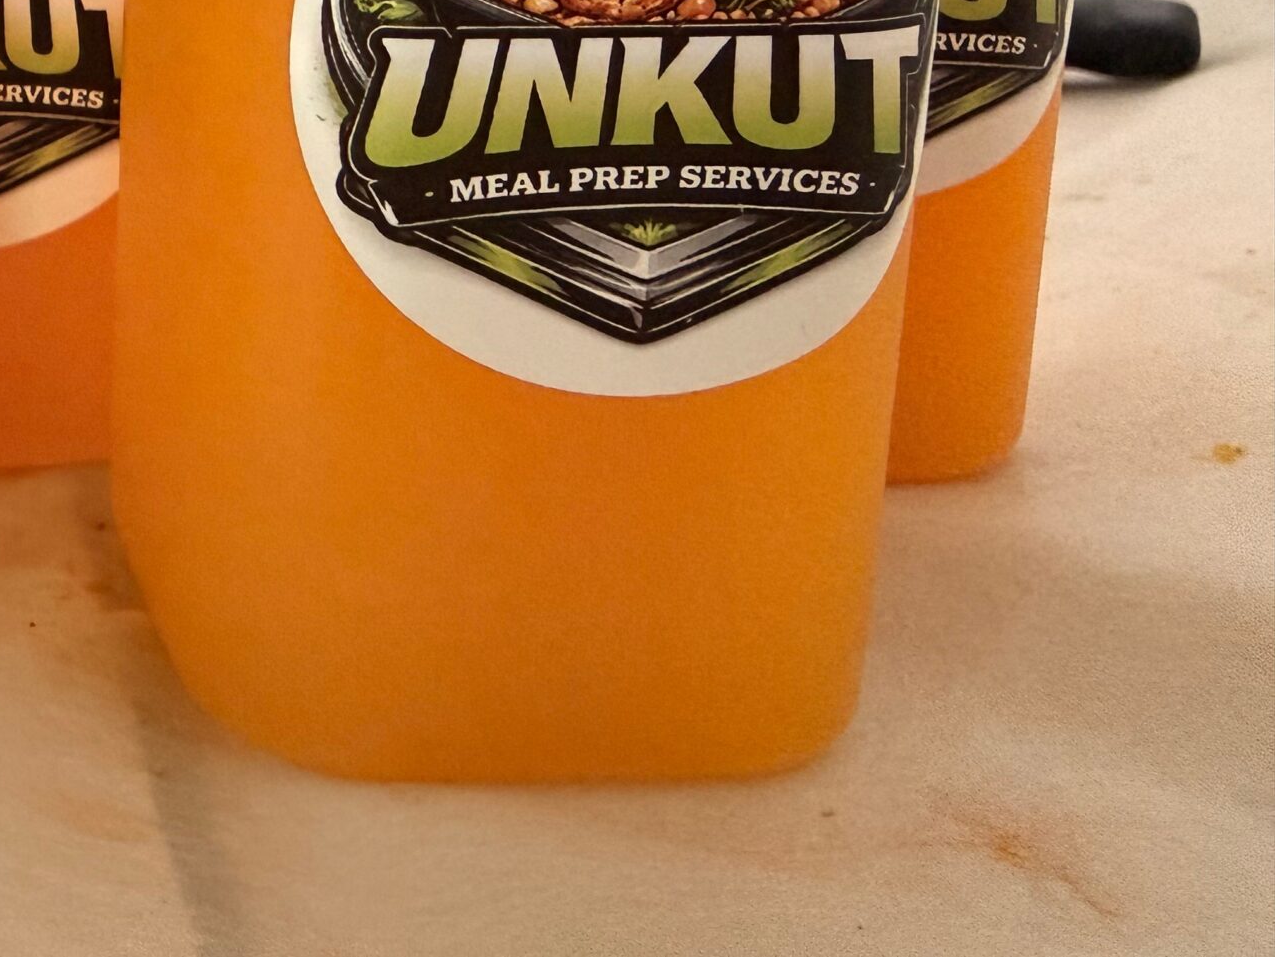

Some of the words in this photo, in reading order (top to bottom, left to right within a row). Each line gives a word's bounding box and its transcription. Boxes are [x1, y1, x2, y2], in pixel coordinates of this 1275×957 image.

[934, 32, 1026, 55] RVICES
[365, 24, 922, 168] UNKUT
[449, 169, 560, 204] MEAL
[570, 166, 671, 193] PREP
[678, 165, 861, 196] SERVICES
